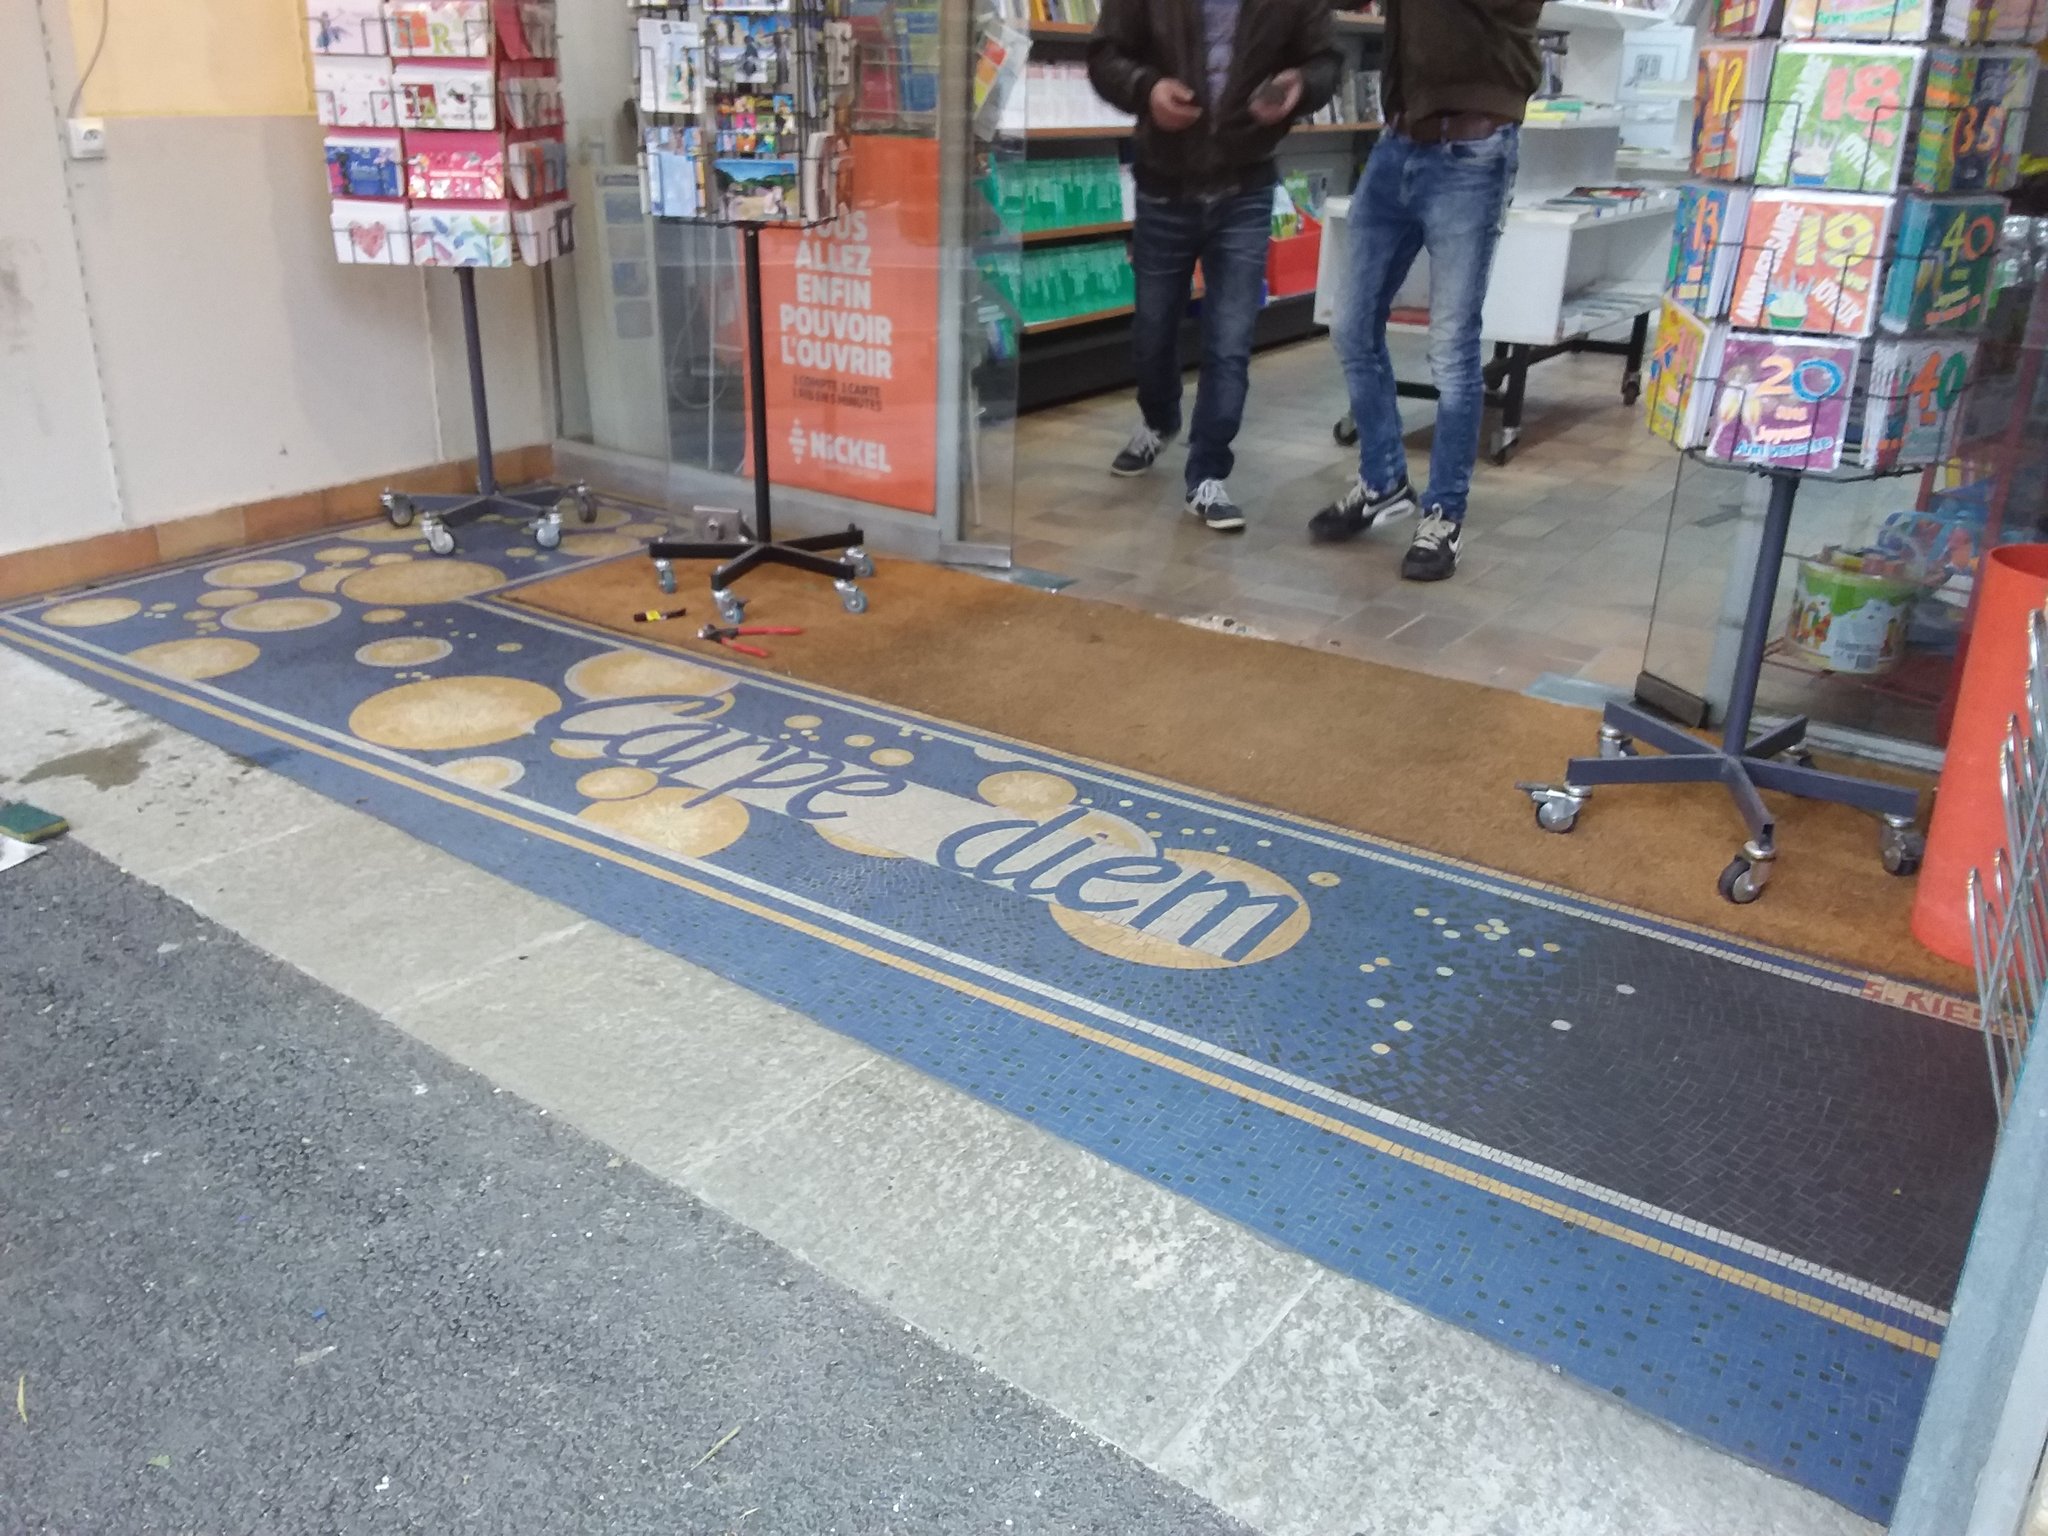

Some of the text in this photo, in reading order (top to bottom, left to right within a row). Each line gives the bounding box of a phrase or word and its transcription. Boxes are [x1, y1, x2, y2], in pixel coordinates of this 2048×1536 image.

[1713, 57, 1743, 117] 12
[1822, 64, 1902, 122] 18
[794, 239, 872, 276] ALLEZ
[1795, 210, 1875, 267] 19
[1940, 208, 1996, 268] 40
[796, 272, 871, 309] ENFIN
[780, 303, 893, 346] POUVOIR
[781, 335, 893, 379] L'OUVRIR
[1754, 354, 1846, 402] 20
[1907, 351, 1967, 411] 40
[536, 693, 1300, 963] Carpe diem
